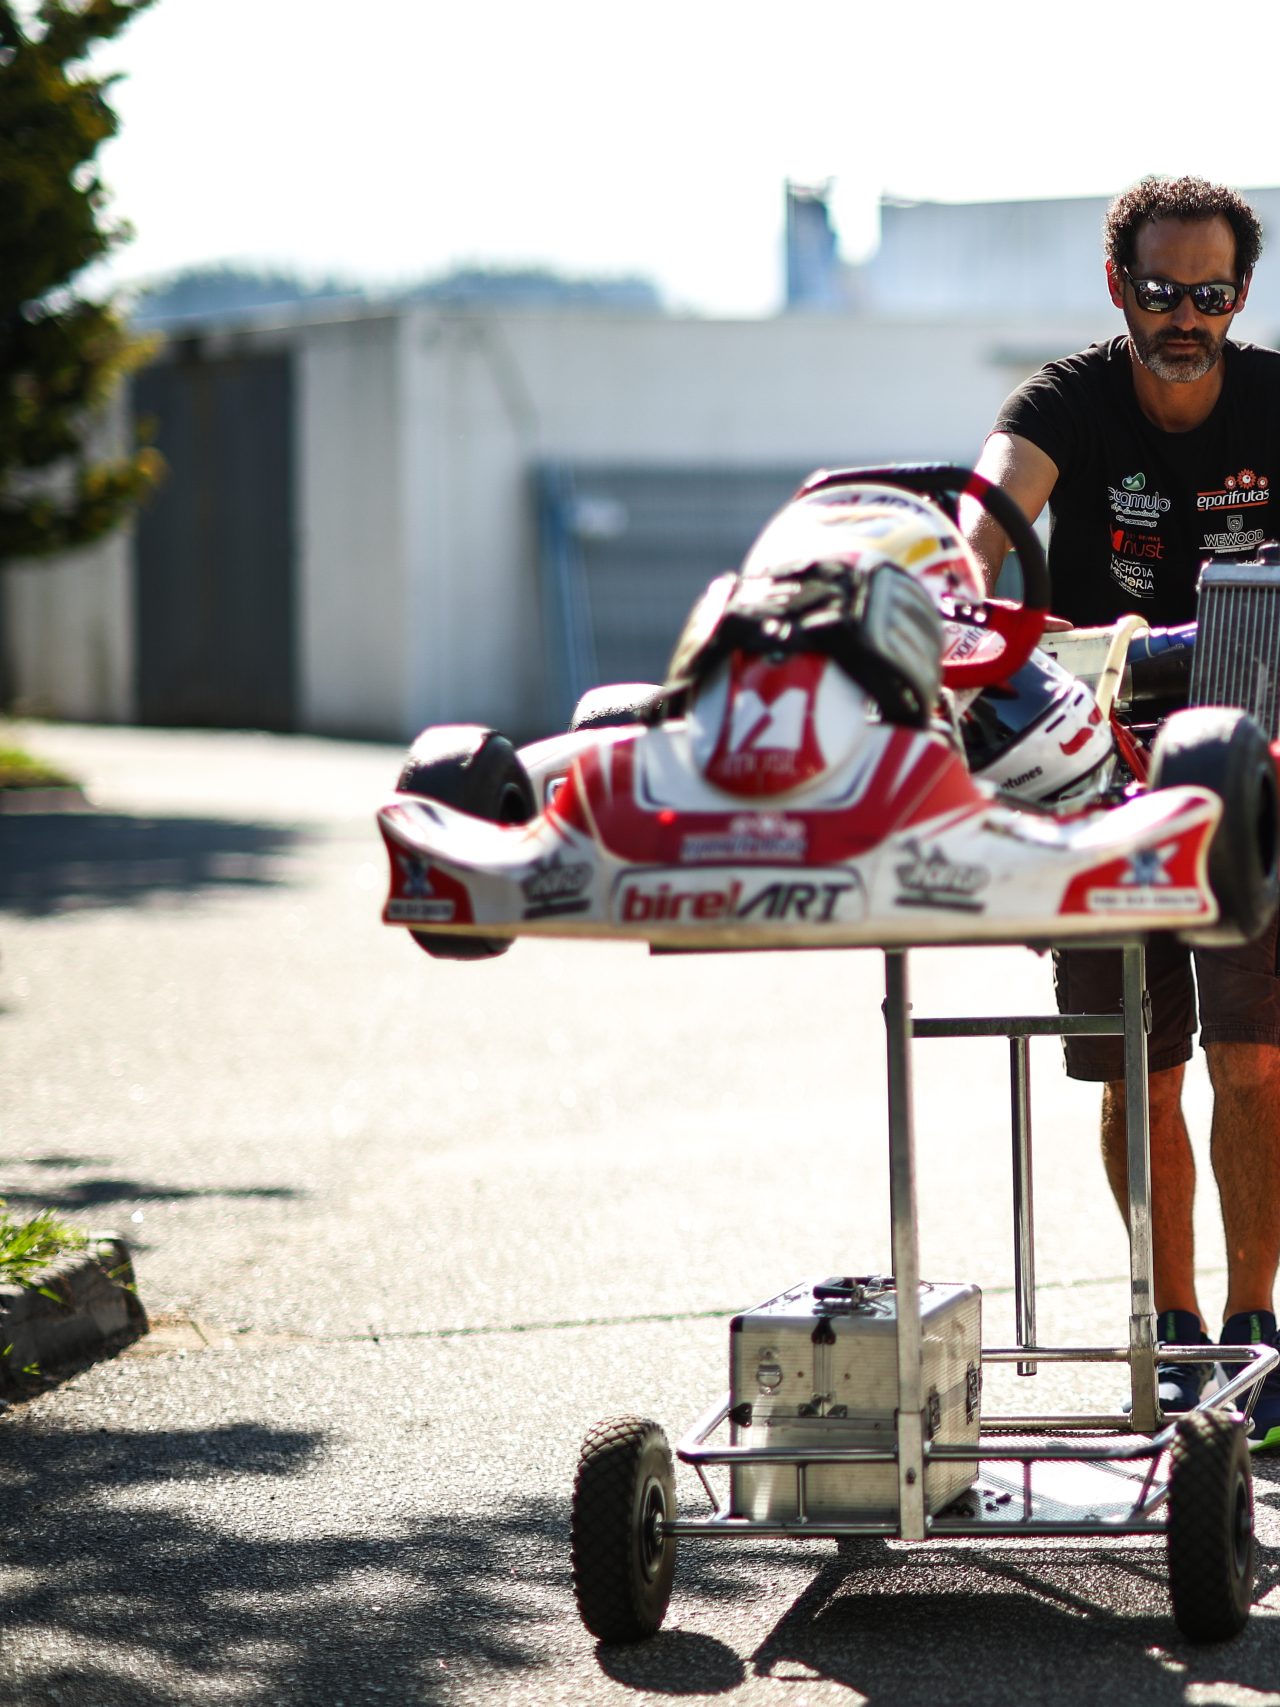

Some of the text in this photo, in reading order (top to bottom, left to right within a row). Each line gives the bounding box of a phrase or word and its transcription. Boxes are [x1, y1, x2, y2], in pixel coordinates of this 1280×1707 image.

[1197, 488, 1270, 511] eporifrutas
[1203, 528, 1264, 547] WEWOOD
[621, 877, 856, 924] birelART
